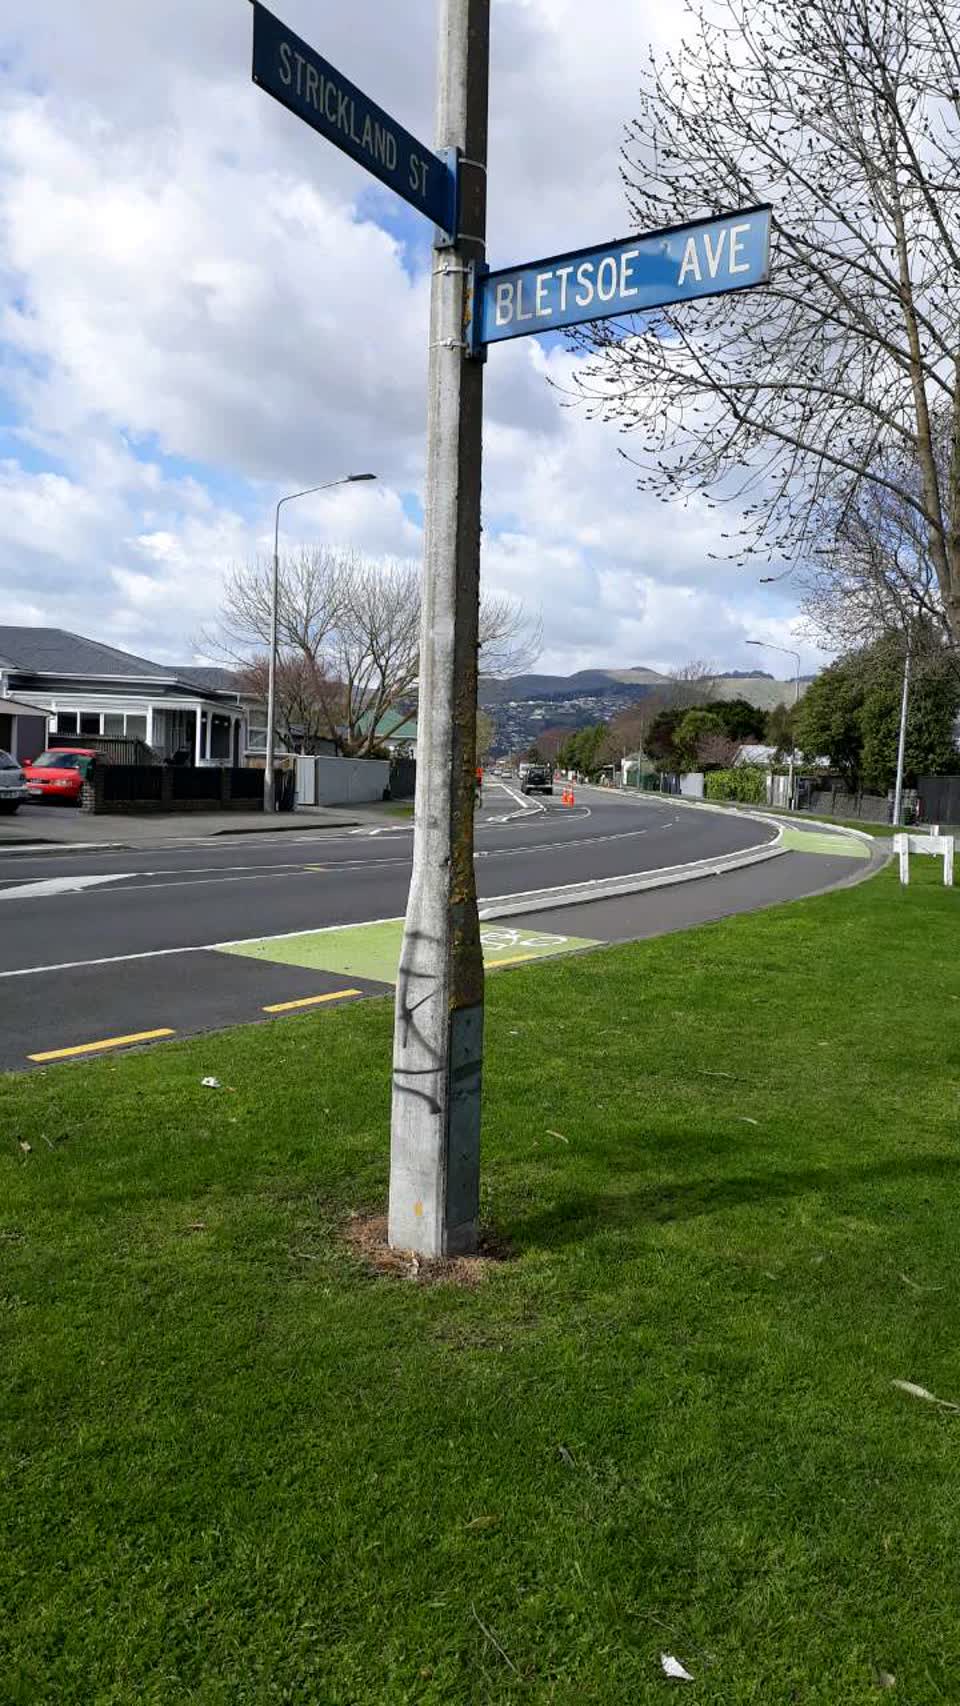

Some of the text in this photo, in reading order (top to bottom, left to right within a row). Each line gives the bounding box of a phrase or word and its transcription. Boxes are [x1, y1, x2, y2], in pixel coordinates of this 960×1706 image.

[279, 43, 429, 197] STRICKLAND ST
[495, 224, 750, 325] BLETSOE AVE
